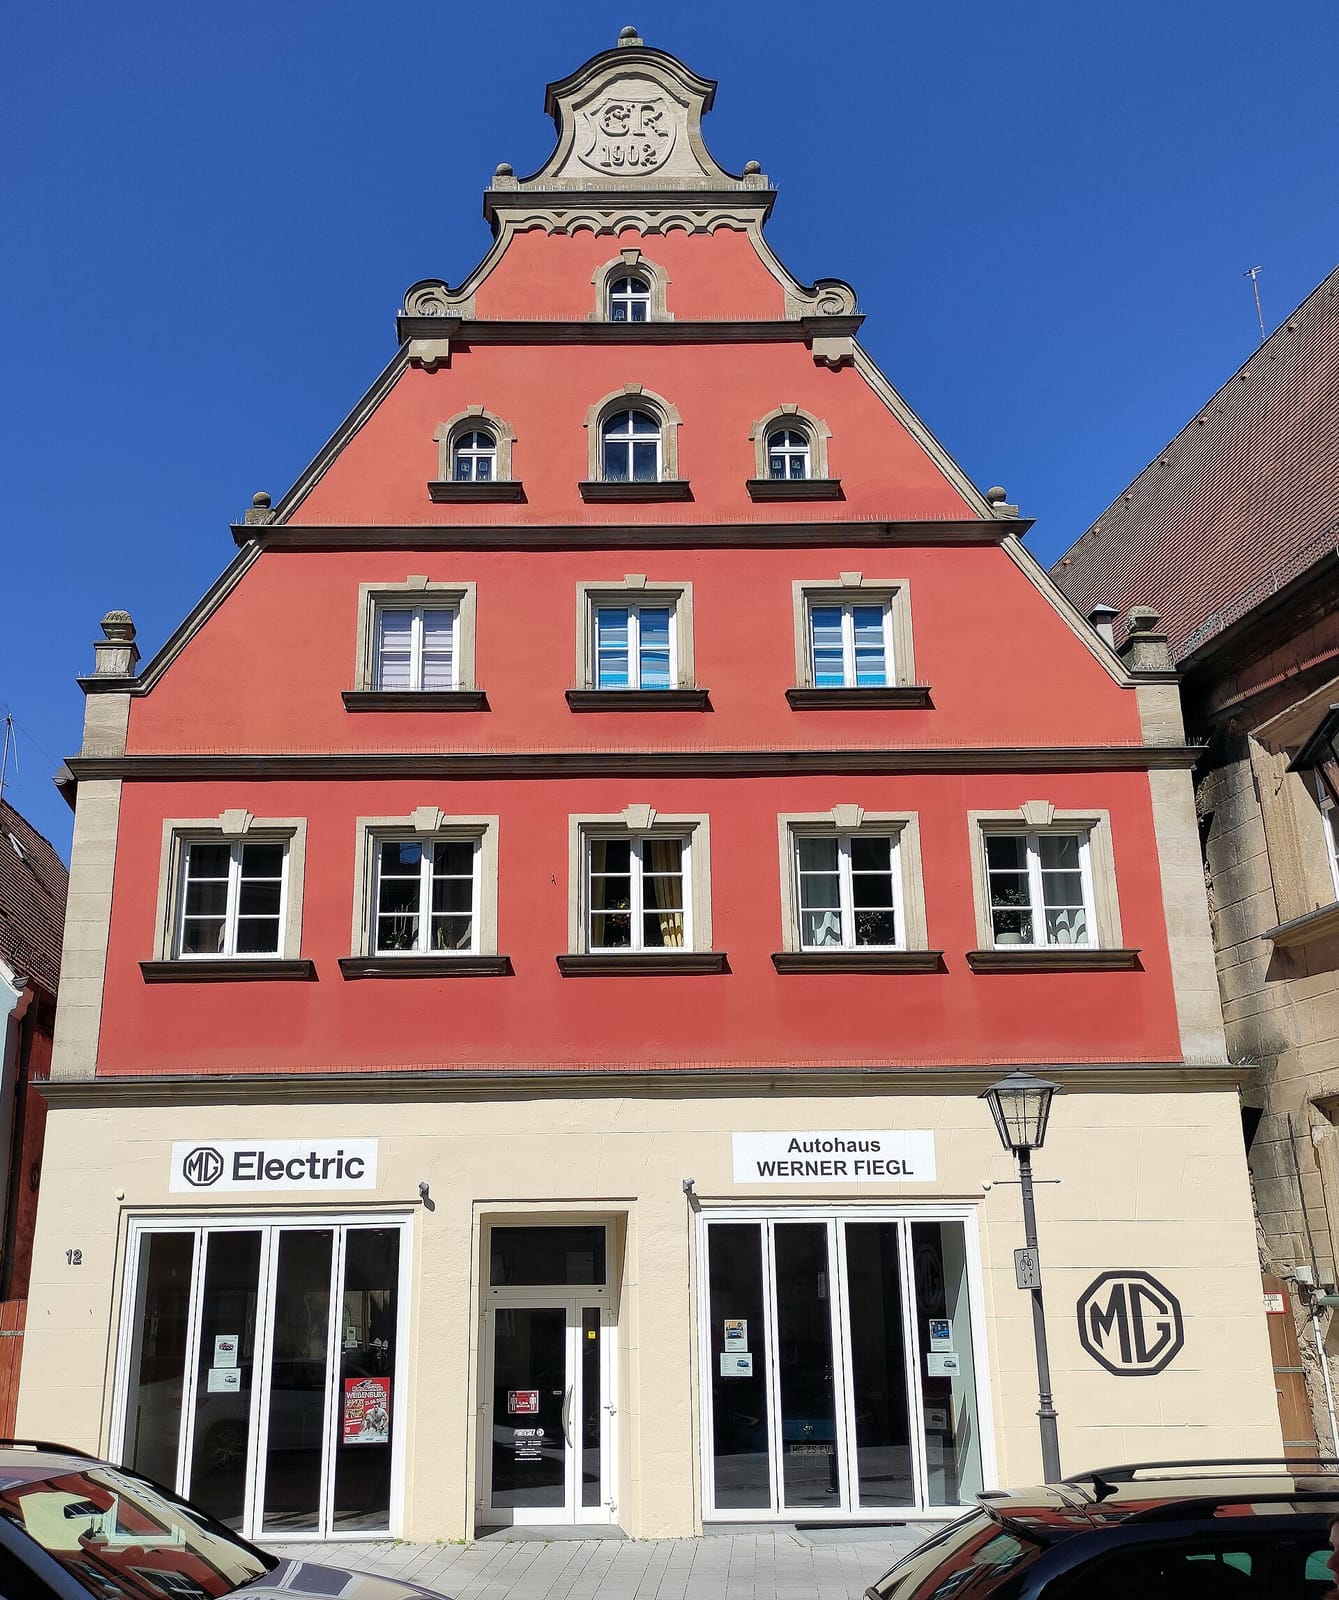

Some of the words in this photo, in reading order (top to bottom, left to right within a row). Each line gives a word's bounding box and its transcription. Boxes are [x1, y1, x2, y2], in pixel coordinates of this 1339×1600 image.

[600, 144, 658, 167] 1902
[787, 1137, 881, 1153] Autohaus
[186, 1150, 220, 1183] MG
[231, 1149, 365, 1181] Electric
[756, 1160, 848, 1176] WERNER
[853, 1159, 914, 1175] FIEGL
[66, 1249, 83, 1265] 12
[1087, 1280, 1174, 1367] MG
